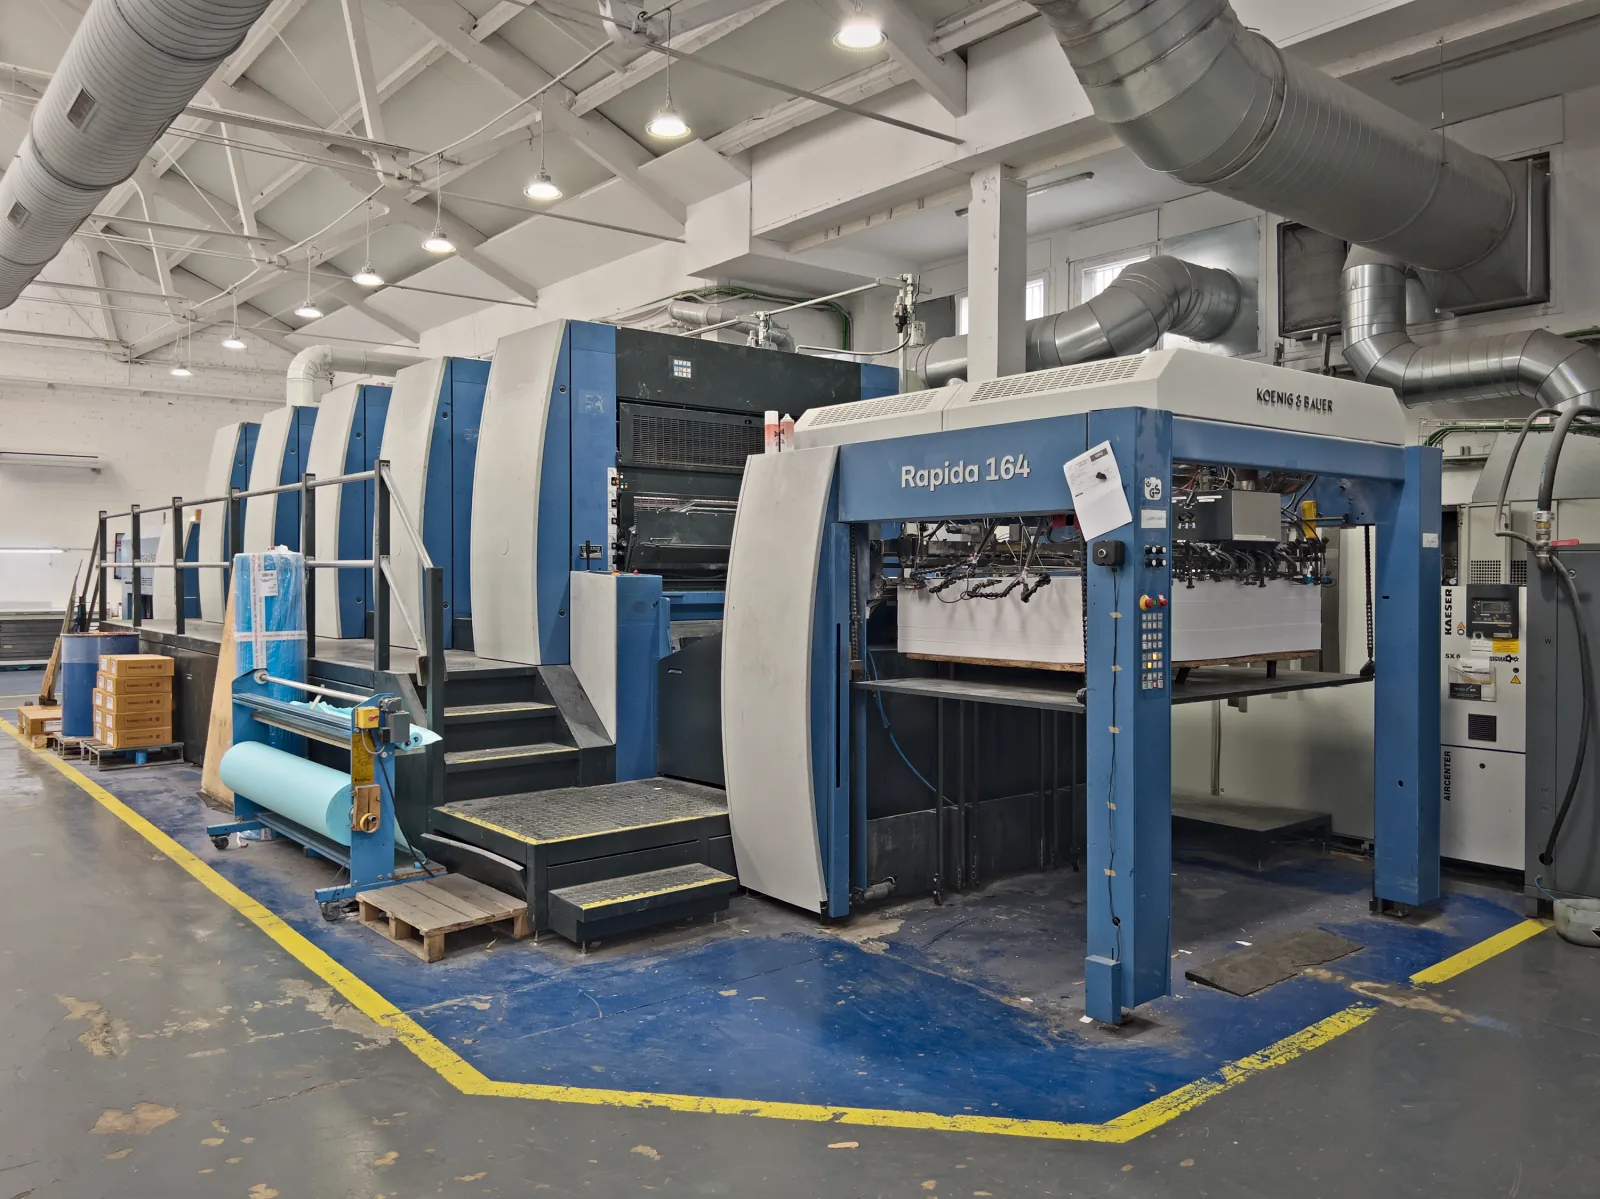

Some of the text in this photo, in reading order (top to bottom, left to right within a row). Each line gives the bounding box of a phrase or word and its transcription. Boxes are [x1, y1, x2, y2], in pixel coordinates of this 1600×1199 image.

[1256, 388, 1333, 413] KOENIG & BAUER
[901, 454, 1031, 492] Rapida 164
[1444, 588, 1453, 636] KAESER
[1443, 750, 1451, 802] AIRCENTER
